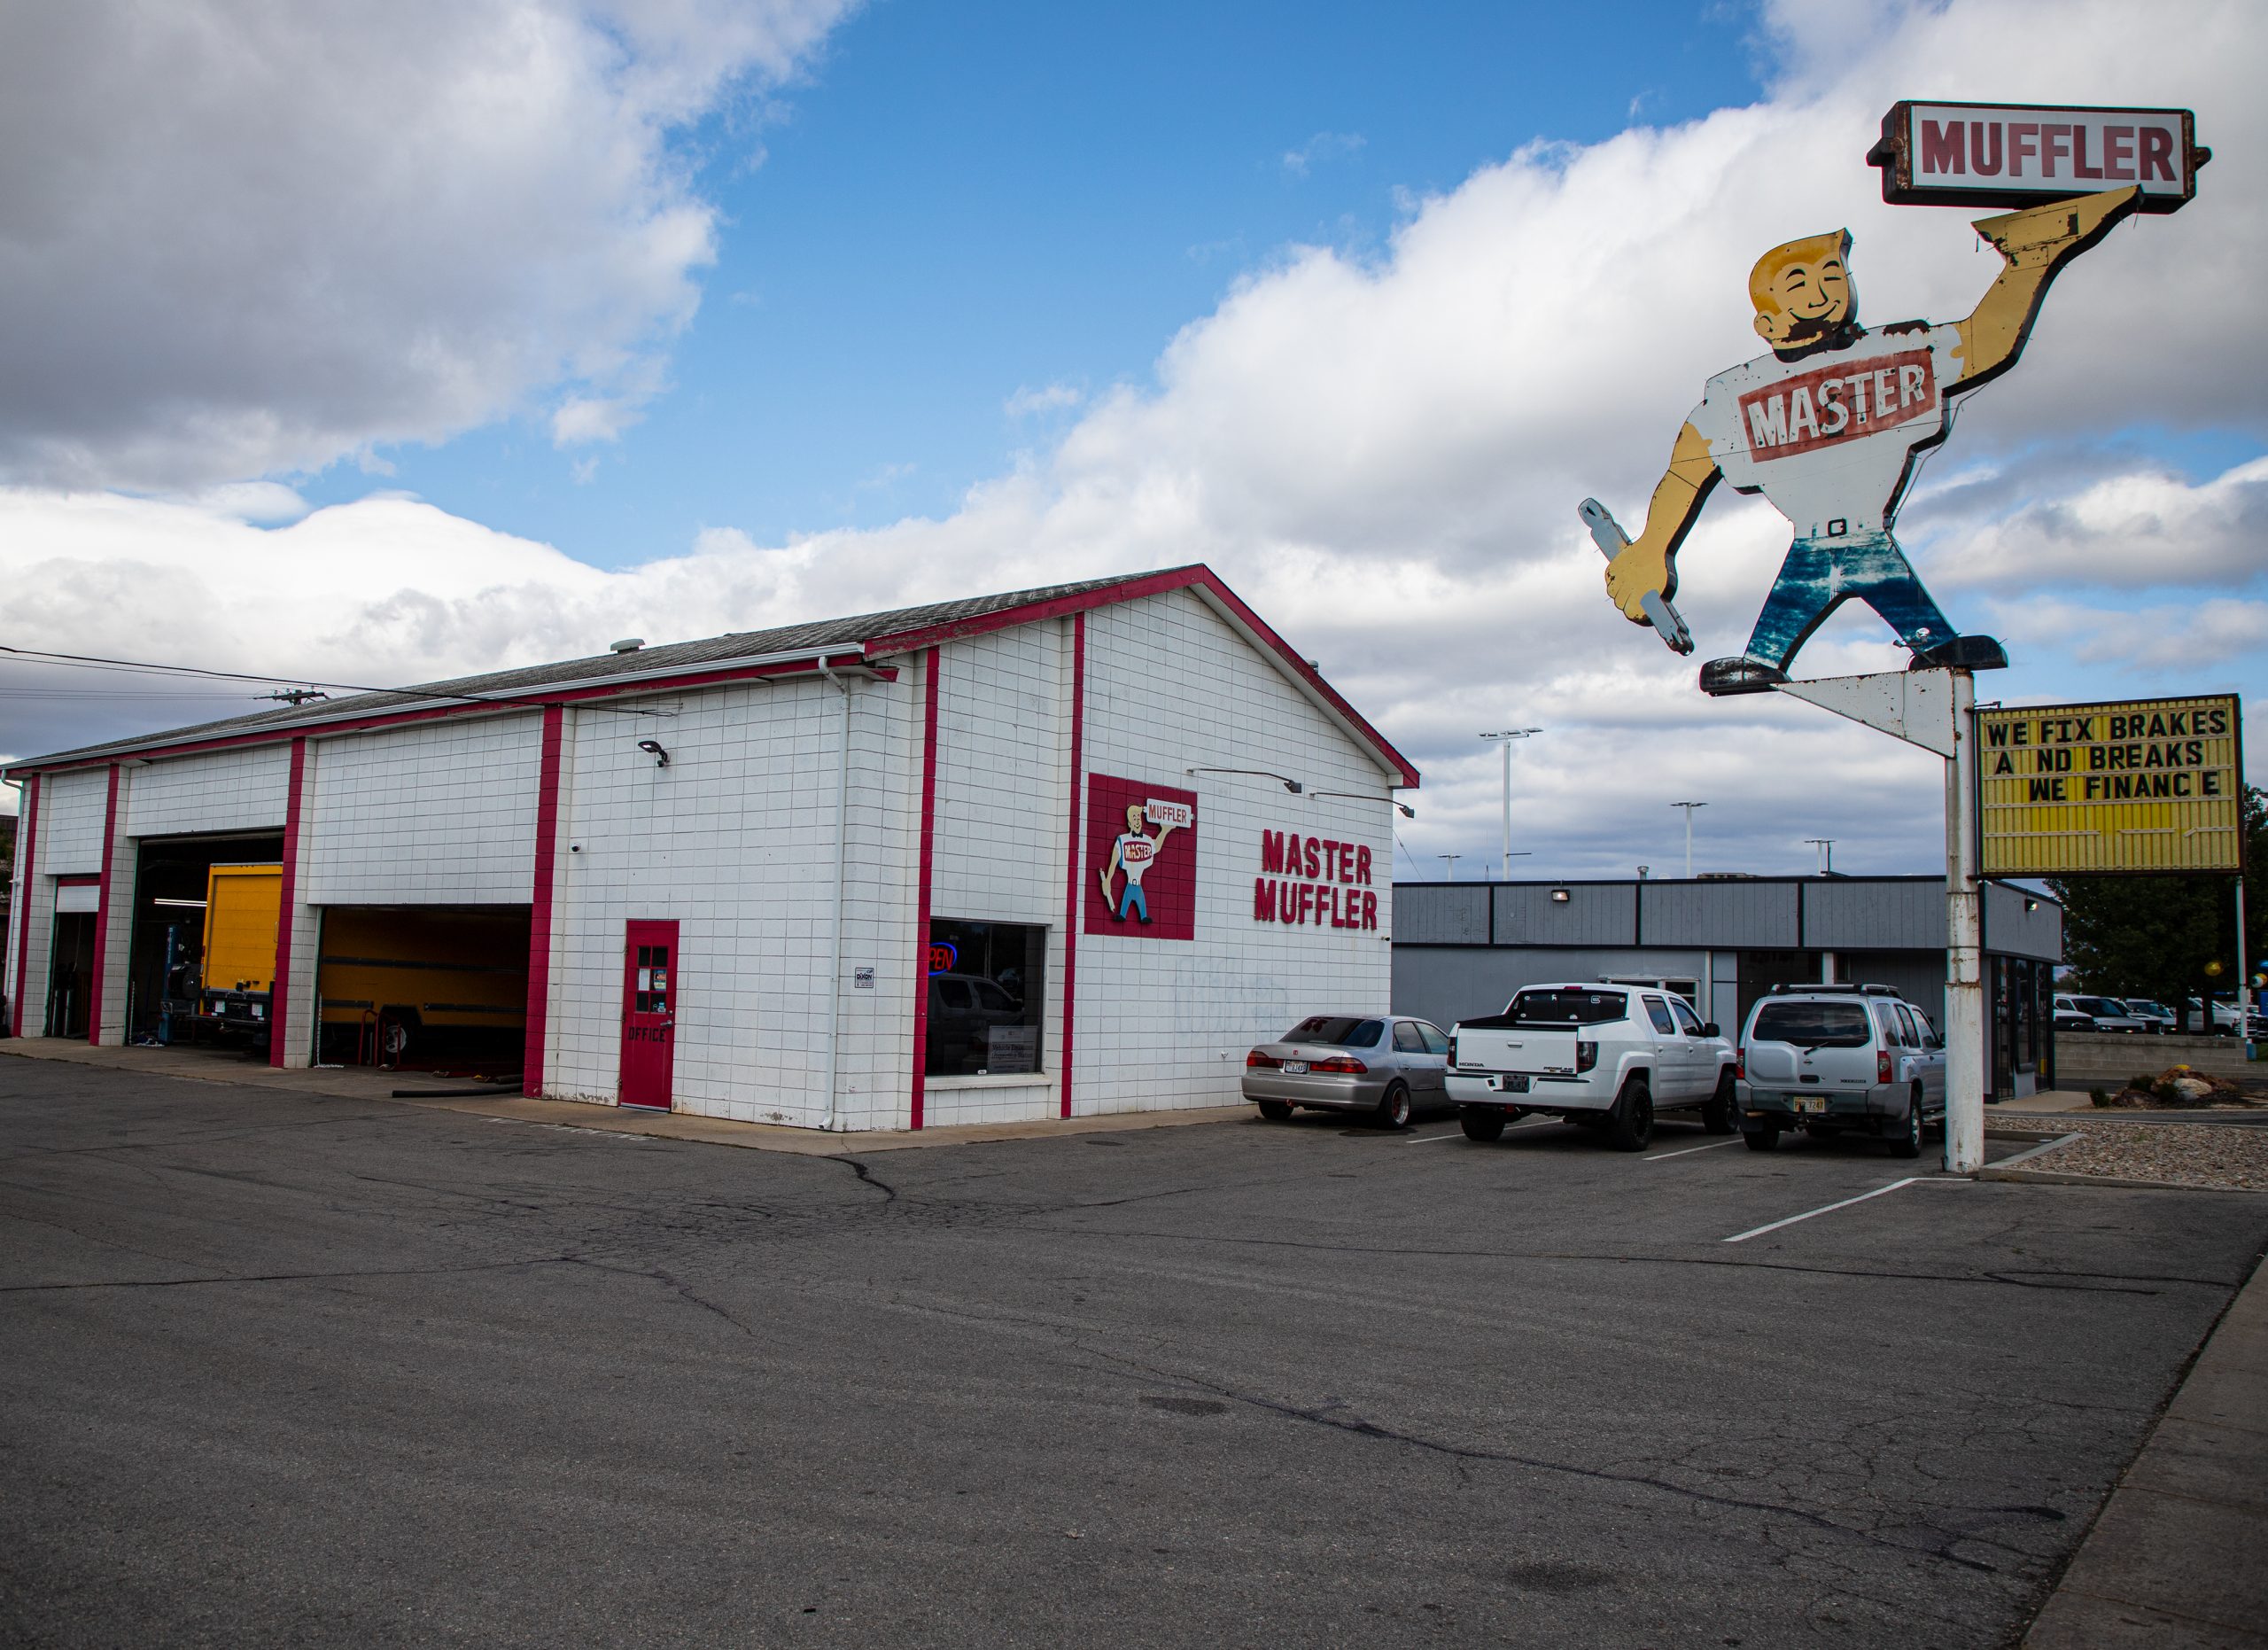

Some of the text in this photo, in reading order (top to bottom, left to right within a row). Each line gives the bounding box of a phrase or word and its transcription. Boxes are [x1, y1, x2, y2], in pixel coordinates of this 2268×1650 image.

[1921, 119, 2178, 183] MUFFLER
[1746, 362, 1927, 449] MASTER
[1987, 710, 2226, 747] WE FIX BRAKES
[2090, 741, 2203, 770] BREAKS
[2029, 778, 2067, 802] WE
[1148, 804, 1187, 824] MUFFLER
[1124, 844, 1153, 860] MASTER
[1261, 829, 1372, 885] MASTER
[1254, 877, 1378, 930] MUFFLER
[928, 947, 953, 971] PEN
[627, 1026, 667, 1043] OFFICE
